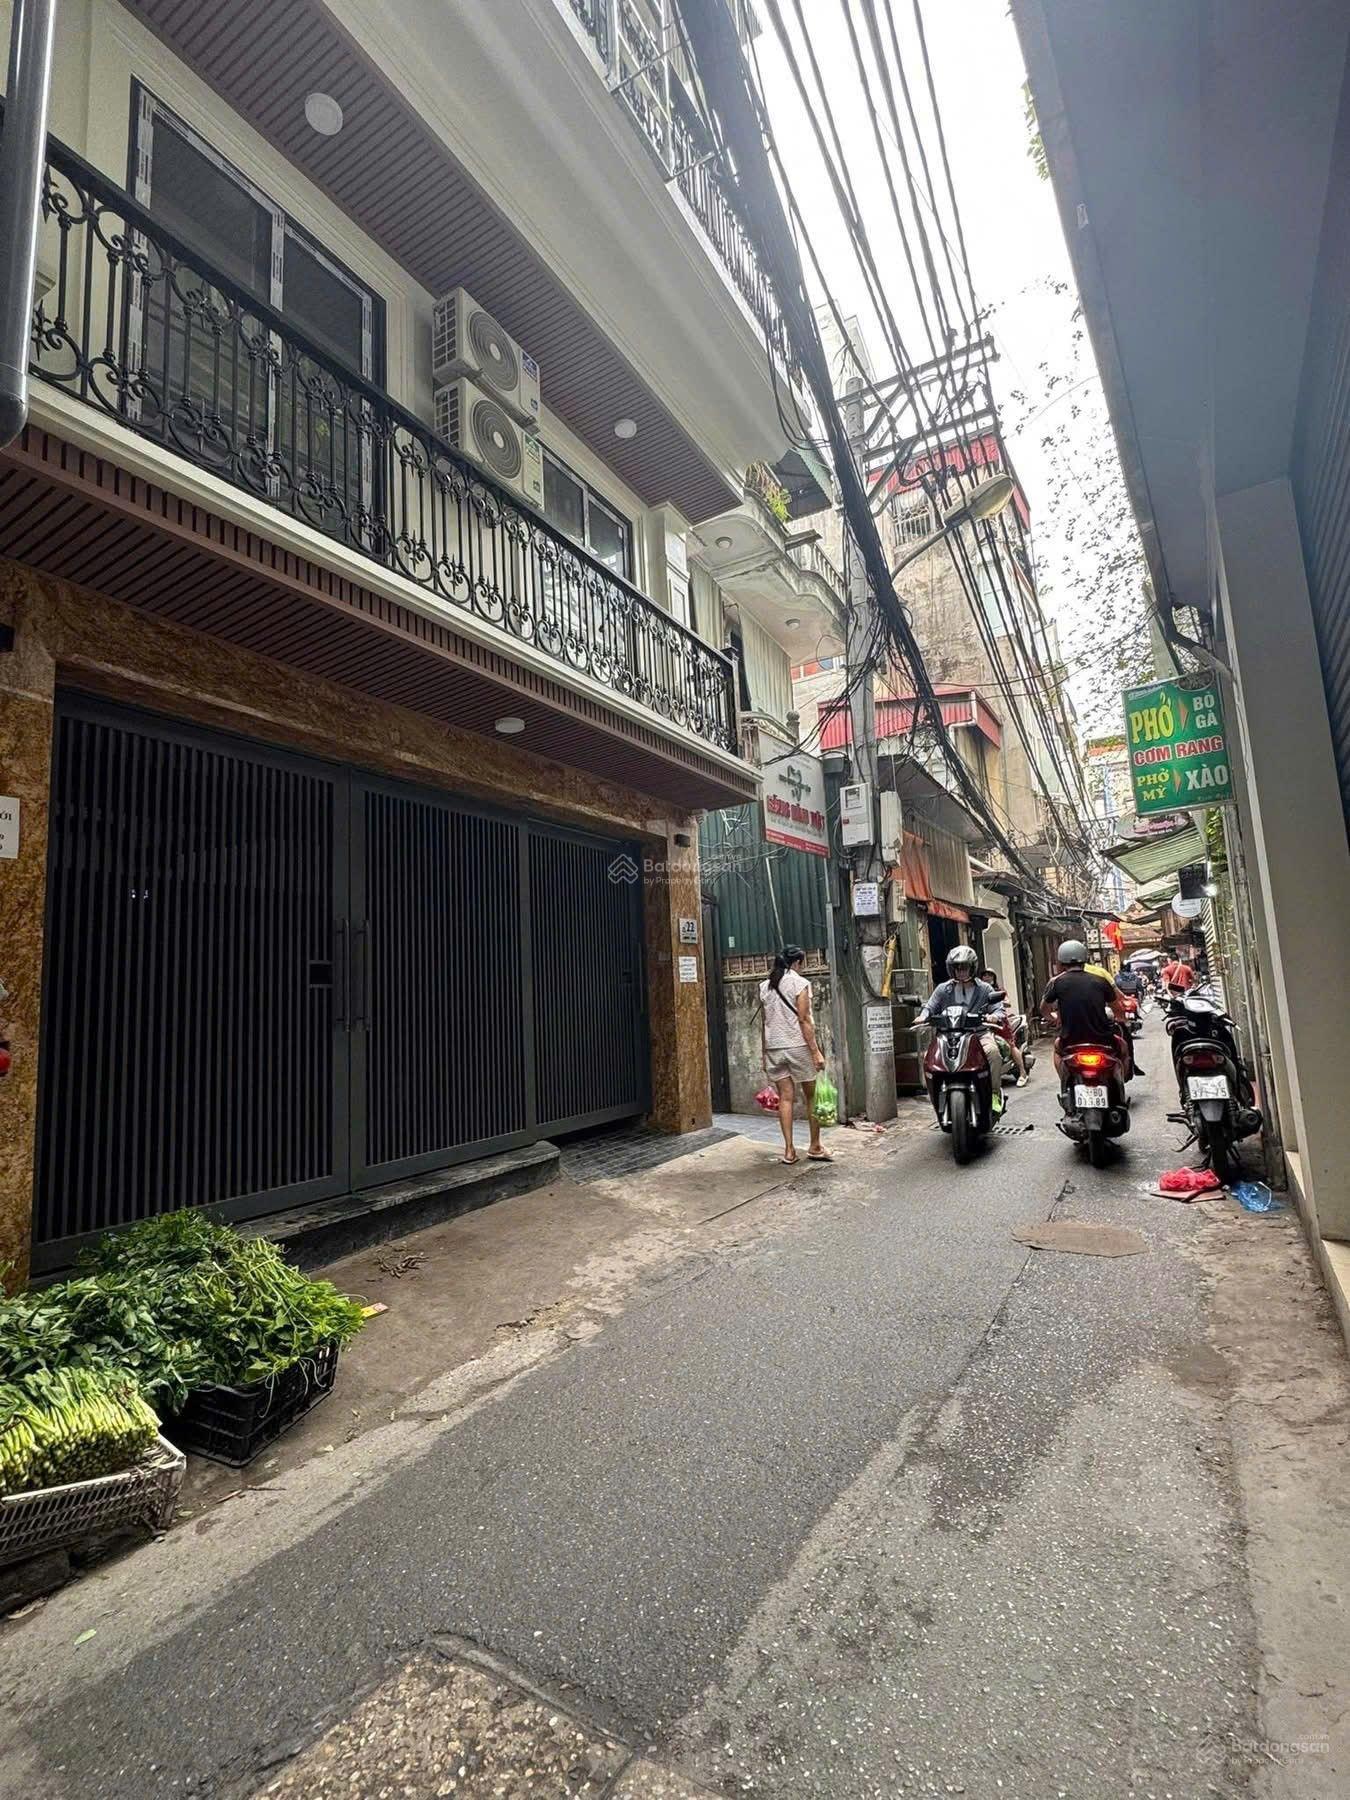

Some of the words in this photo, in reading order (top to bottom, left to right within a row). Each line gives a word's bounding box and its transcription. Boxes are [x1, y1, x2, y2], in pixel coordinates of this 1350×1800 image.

[1193, 692, 1215, 711] BÒ
[1129, 691, 1175, 744] PHỞ
[1195, 711, 1218, 729] GÀ
[1134, 745, 1173, 767] CƠM
[1175, 735, 1224, 759] RANG
[1136, 768, 1170, 787] PHỞ
[1185, 764, 1228, 791] XÀO
